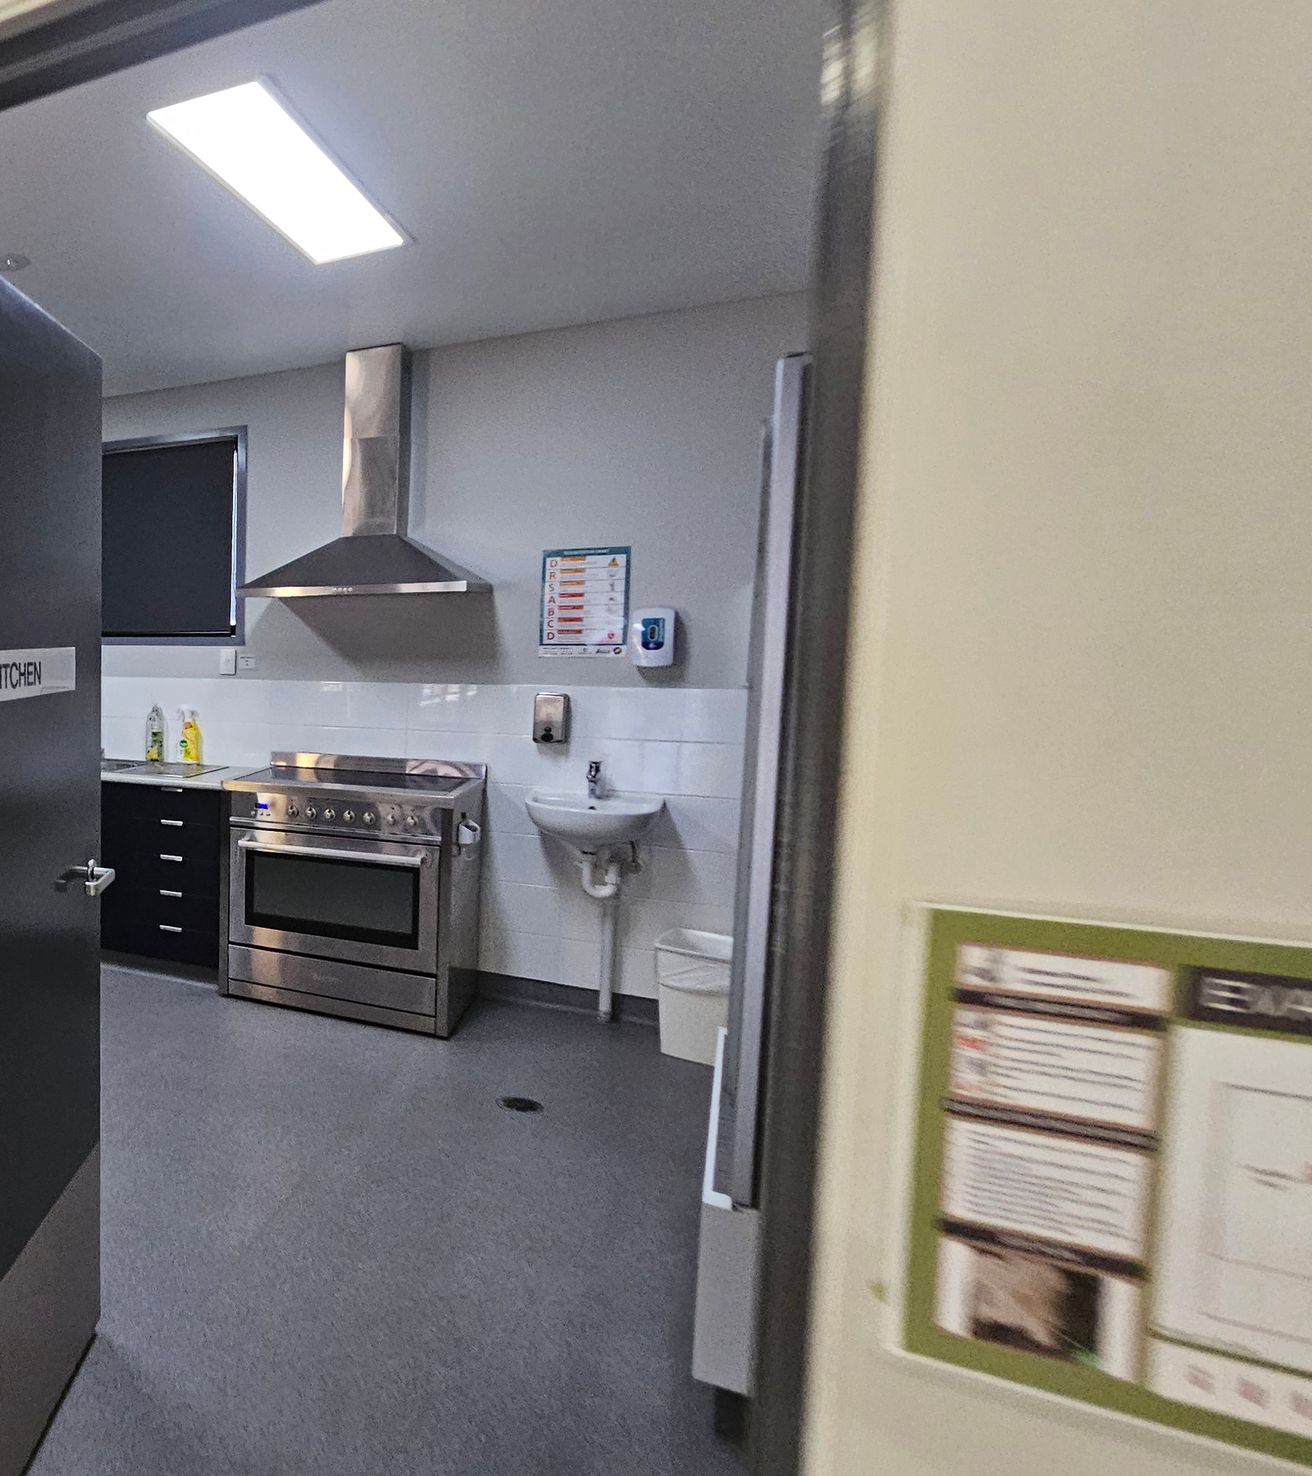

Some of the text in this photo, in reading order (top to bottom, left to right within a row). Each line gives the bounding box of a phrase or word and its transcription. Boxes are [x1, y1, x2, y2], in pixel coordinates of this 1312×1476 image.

[549, 571, 556, 580] R
[548, 583, 555, 592] S
[548, 595, 556, 604] A
[547, 620, 554, 628] C
[547, 632, 555, 640] D
